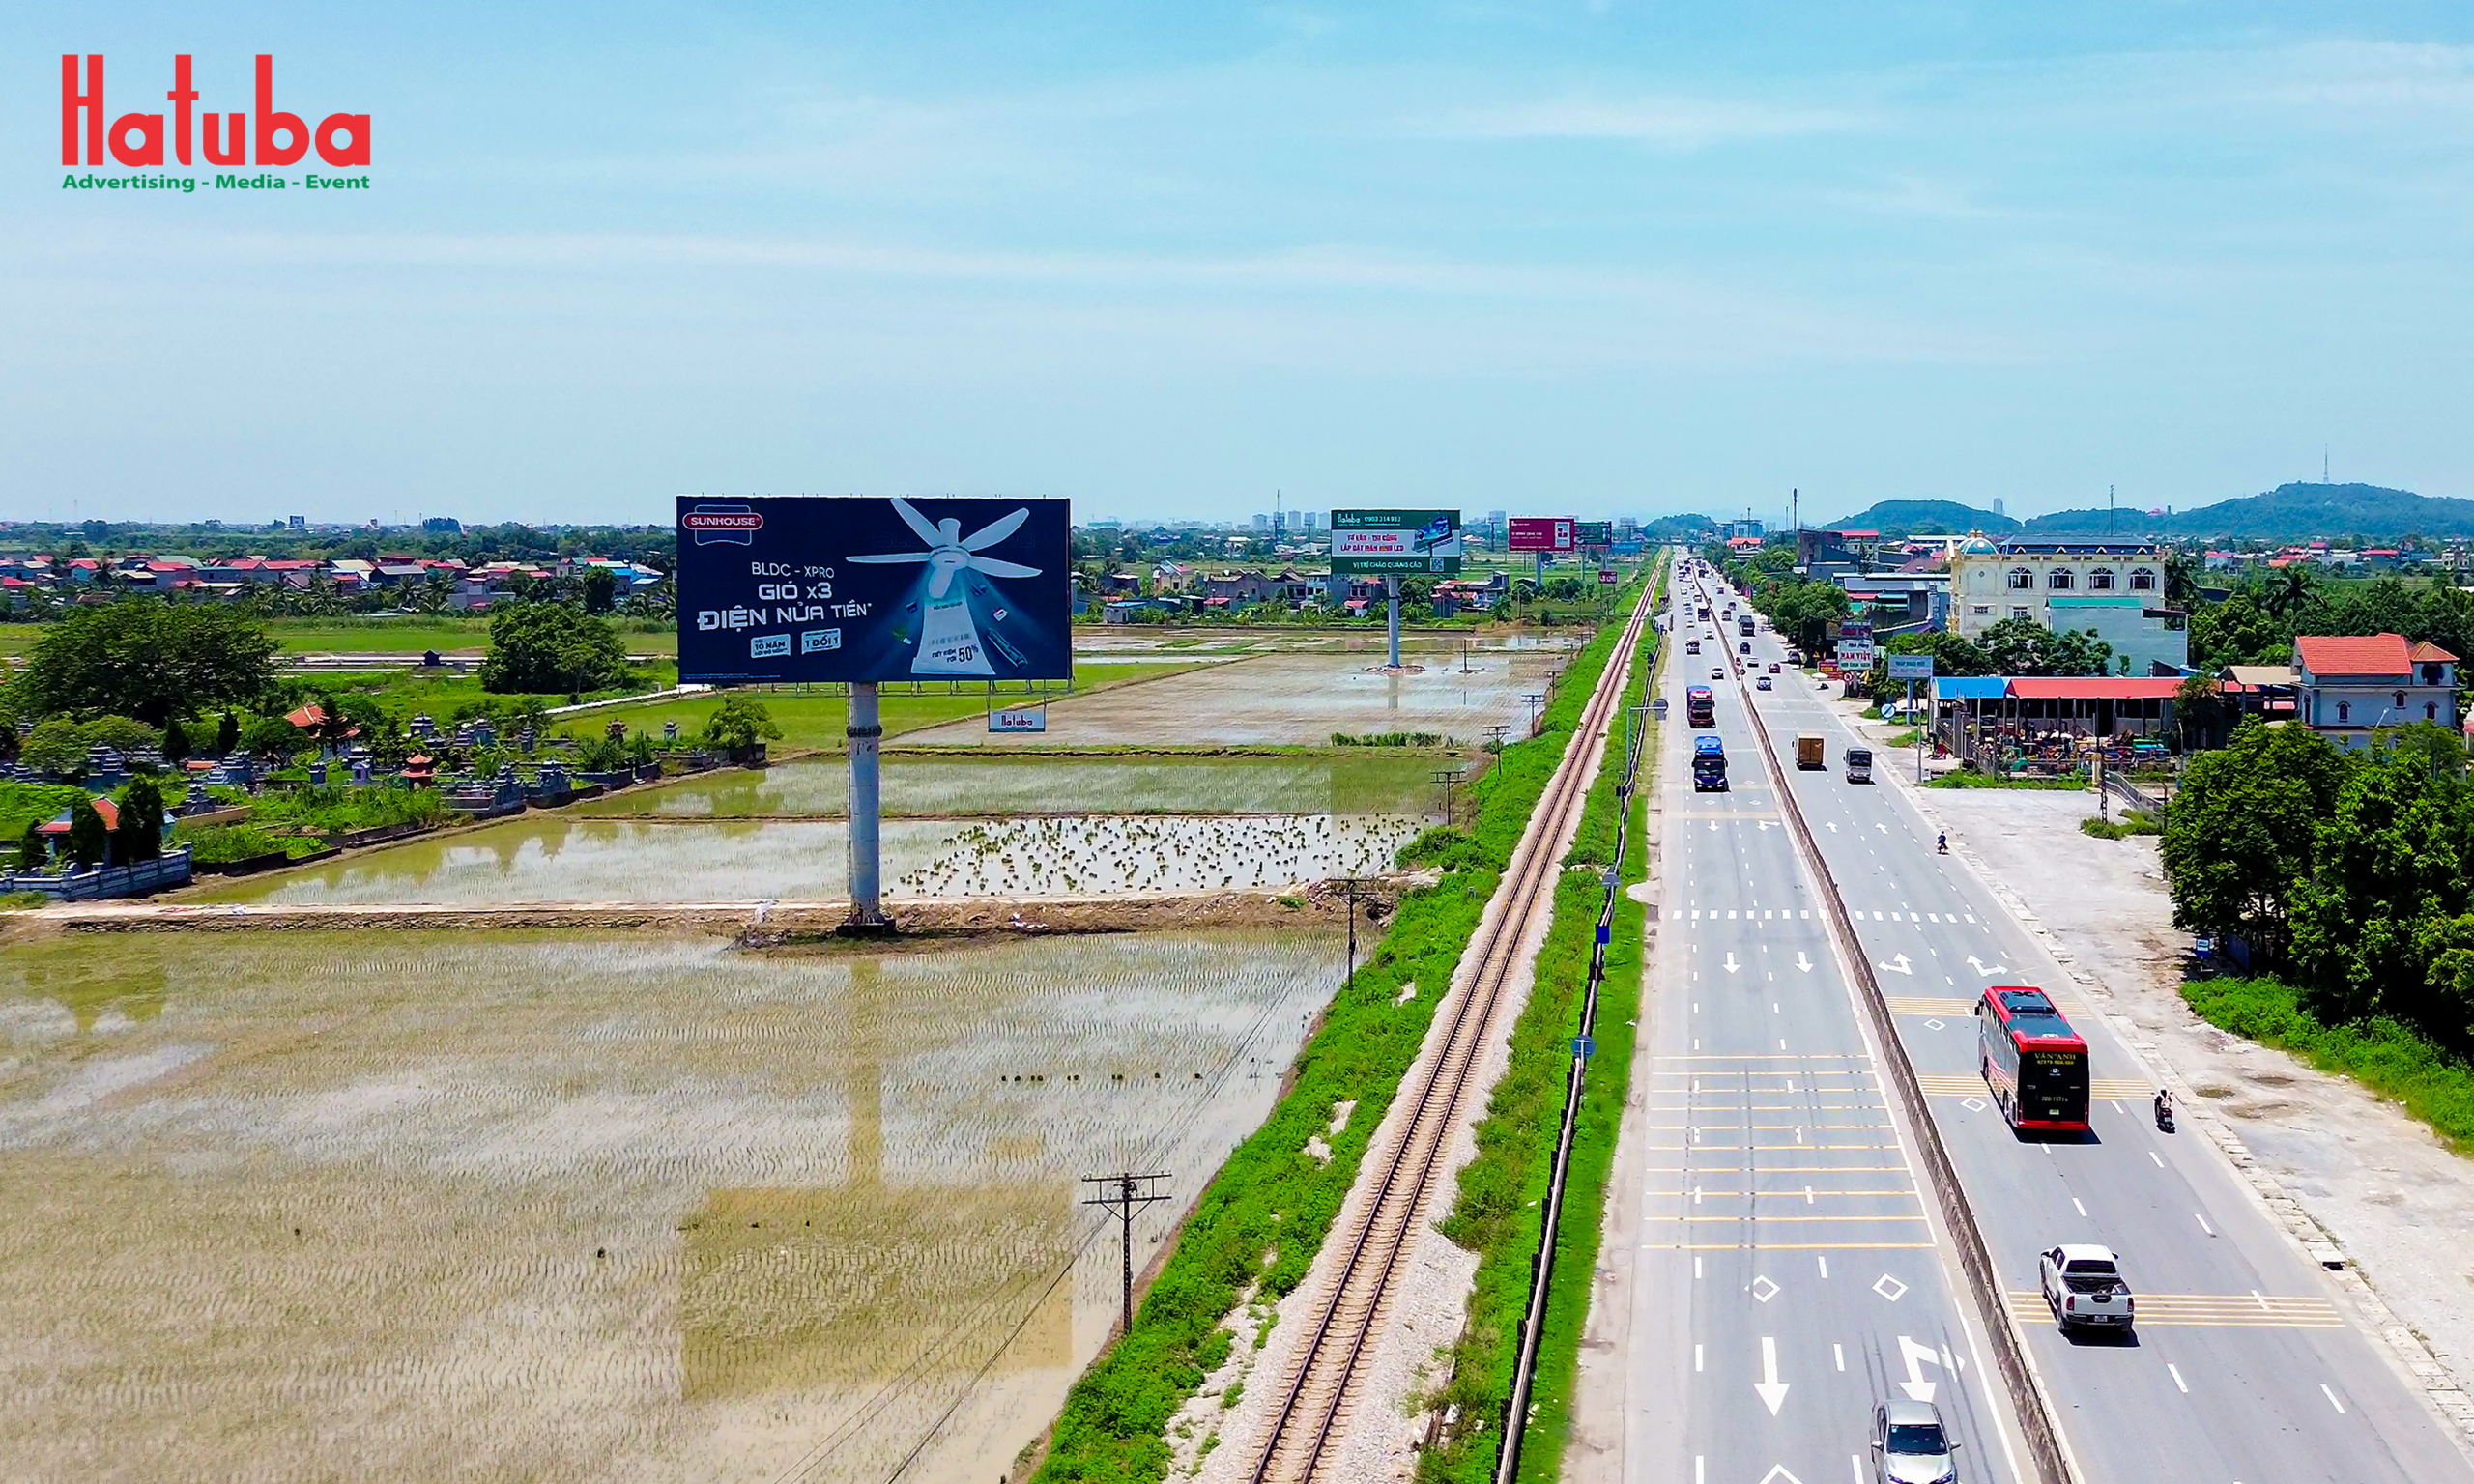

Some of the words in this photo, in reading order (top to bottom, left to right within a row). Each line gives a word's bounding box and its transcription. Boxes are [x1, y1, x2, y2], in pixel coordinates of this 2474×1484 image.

[690, 517, 756, 527] SUNHOUSE
[751, 561, 791, 577] BLDC
[803, 565, 835, 579] XPRO
[758, 580, 798, 600] GIÓ
[806, 582, 833, 600] x3
[697, 605, 767, 632] ĐIỆN
